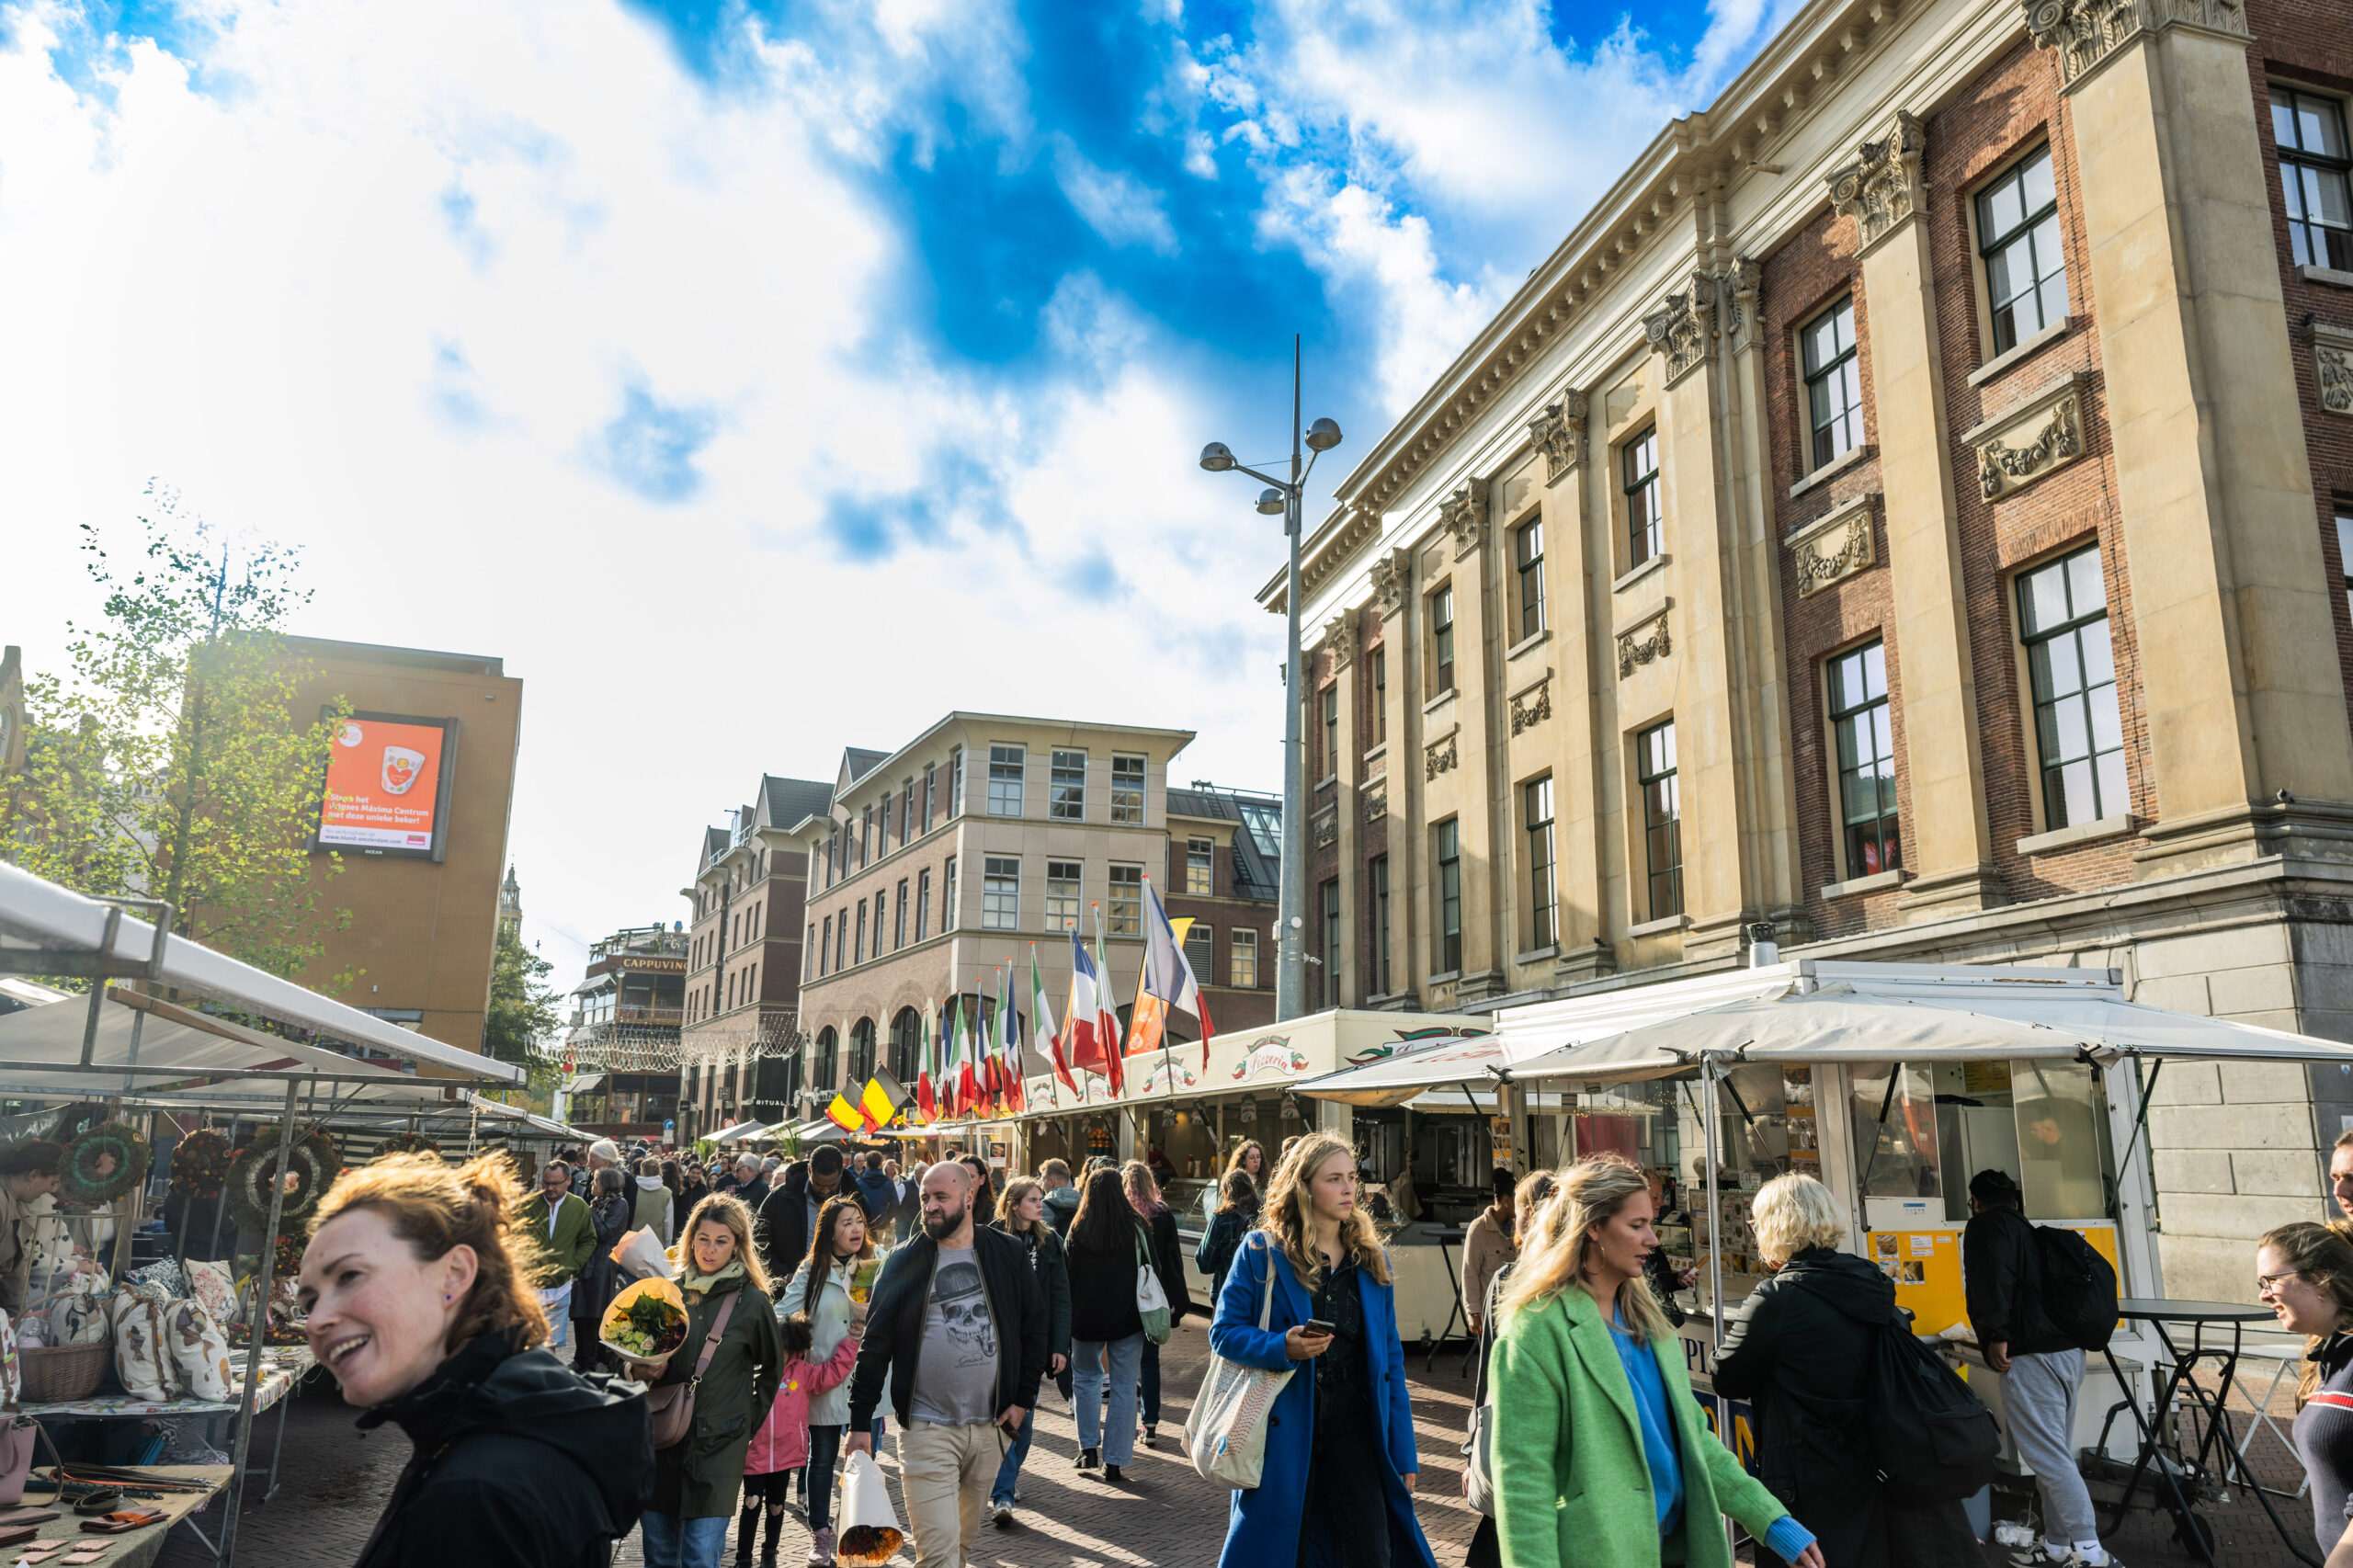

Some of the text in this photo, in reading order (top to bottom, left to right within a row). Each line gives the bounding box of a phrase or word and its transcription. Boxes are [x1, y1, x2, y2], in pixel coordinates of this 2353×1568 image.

[360, 804, 393, 814] Máxima
[394, 807, 429, 816] Centrum
[346, 812, 364, 821] deze
[366, 815, 392, 824] unieke
[394, 816, 420, 824] beker!
